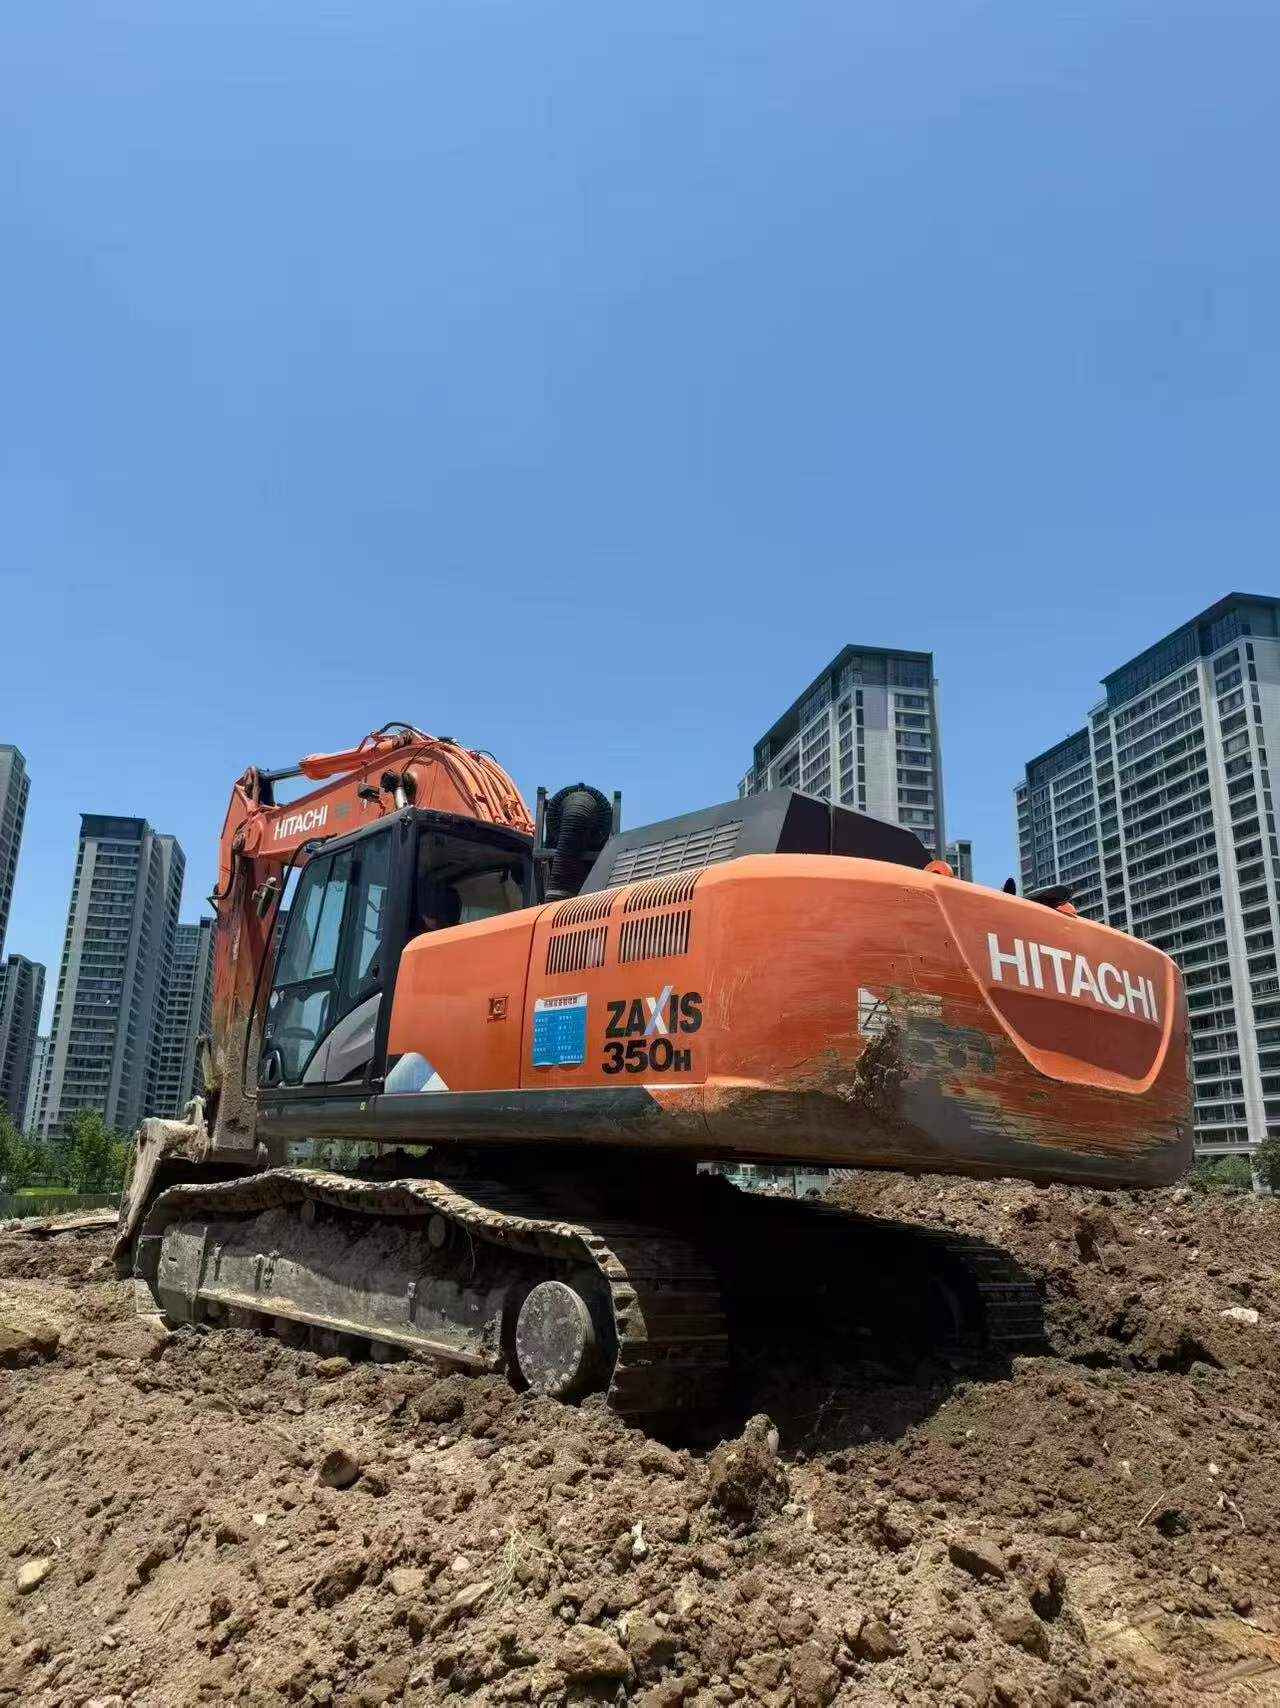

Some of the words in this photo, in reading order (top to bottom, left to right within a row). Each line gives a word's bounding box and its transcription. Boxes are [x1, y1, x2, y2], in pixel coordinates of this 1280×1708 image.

[273, 805, 328, 840] HITACHI
[987, 932, 1160, 1023] HITACHI
[605, 985, 703, 1039] ZAXIS
[601, 1037, 692, 1075] 350H
